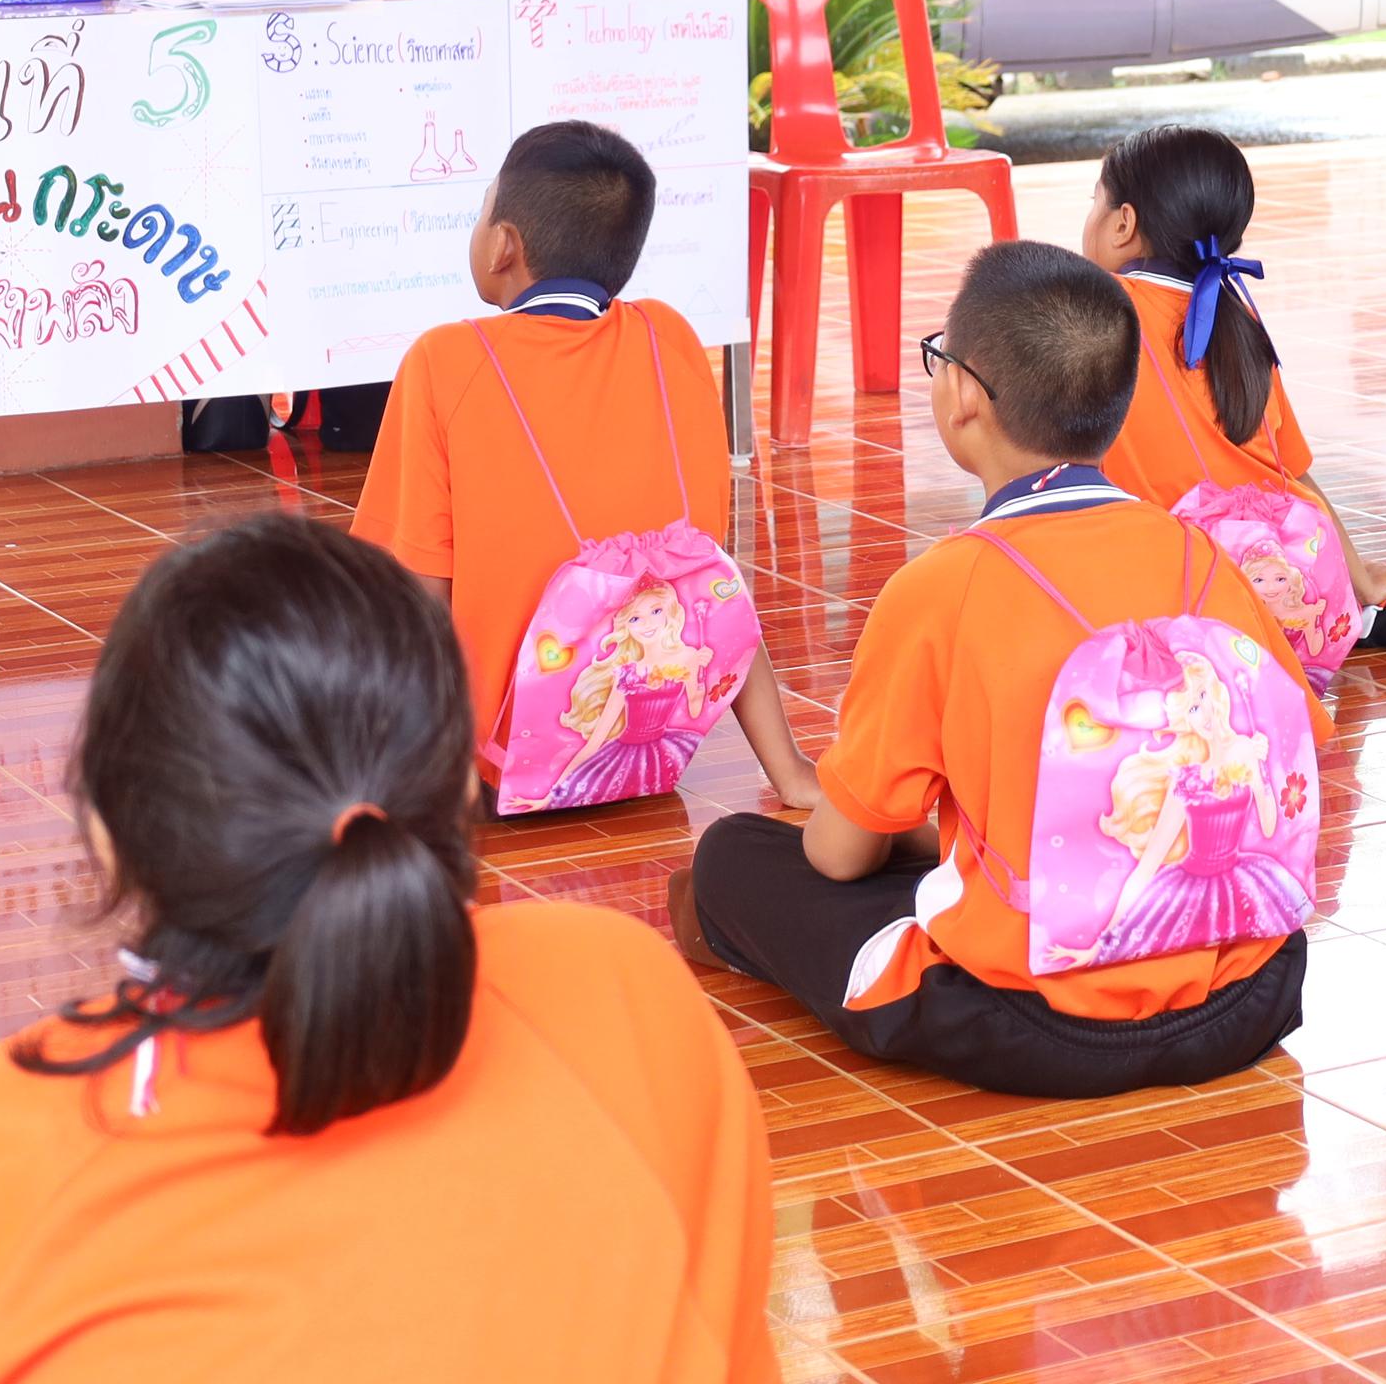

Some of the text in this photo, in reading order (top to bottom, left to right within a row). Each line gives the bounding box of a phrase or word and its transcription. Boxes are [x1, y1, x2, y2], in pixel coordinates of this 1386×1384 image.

[326, 21, 394, 66] Science
[575, 3, 654, 54] Technology
[130, 19, 217, 130] 5
[319, 201, 398, 250] Engineering
